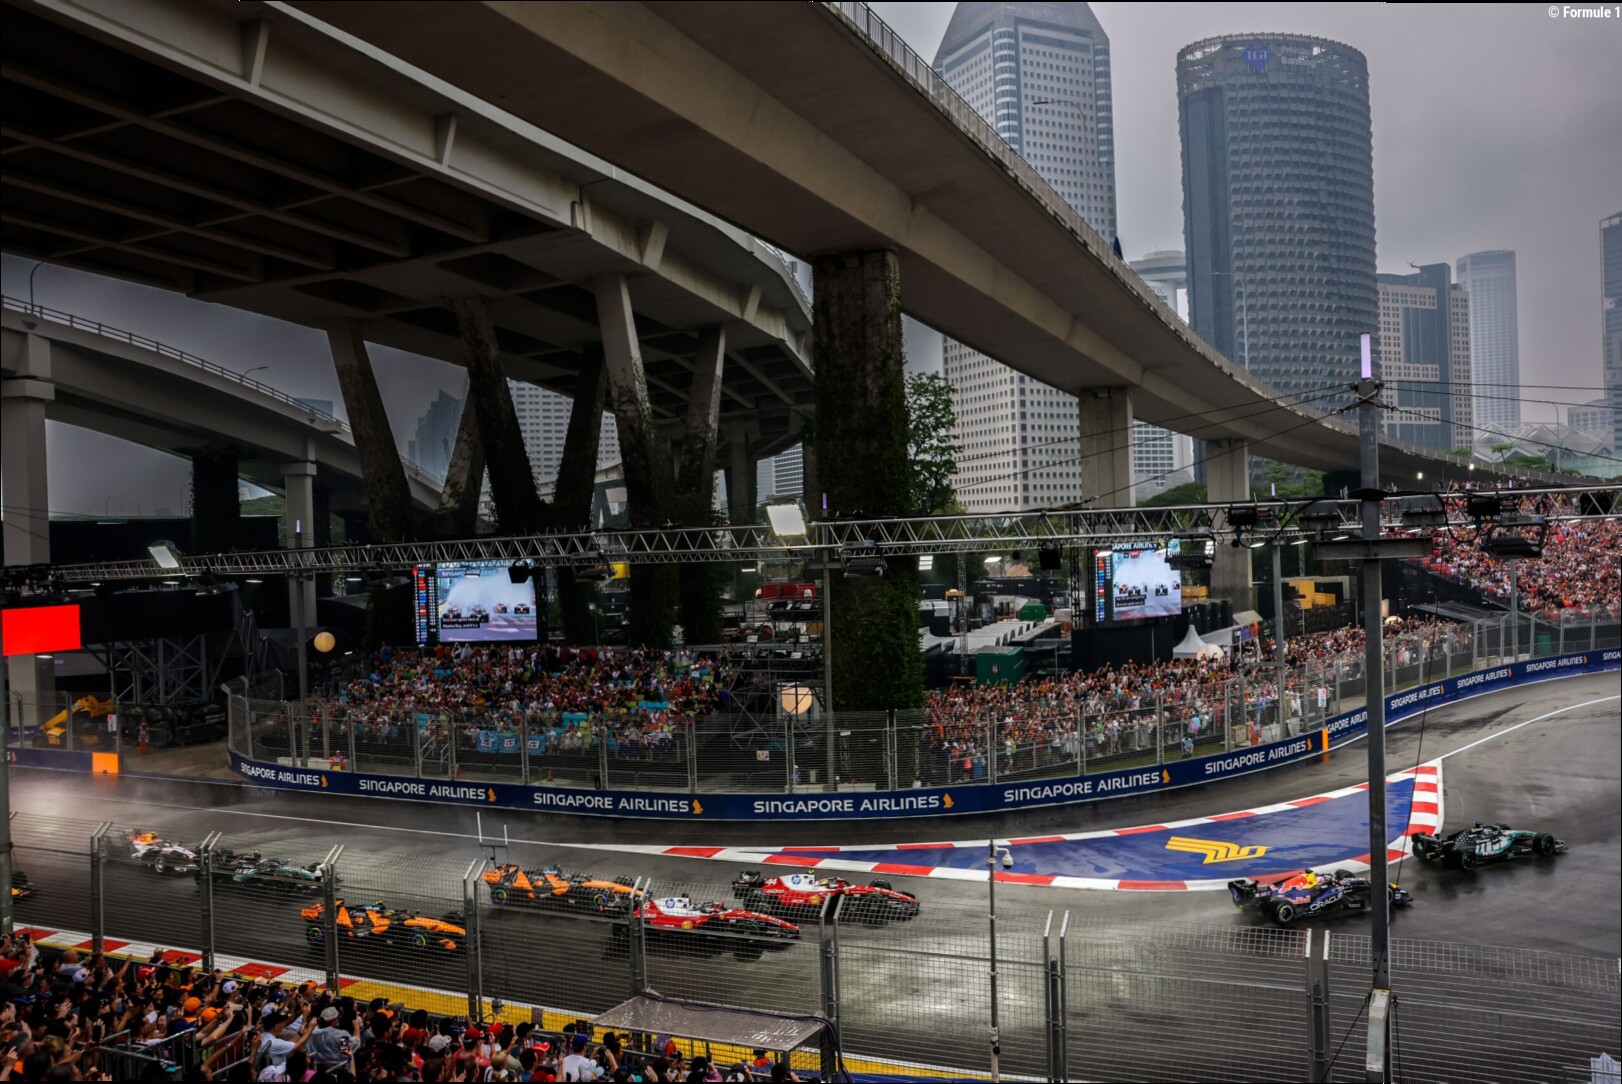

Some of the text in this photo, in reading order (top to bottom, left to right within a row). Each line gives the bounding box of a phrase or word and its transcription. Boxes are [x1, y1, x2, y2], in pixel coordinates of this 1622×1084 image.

[1526, 655, 1583, 673] SINGAPORE AIRLINES
[1603, 650, 1621, 660] SINGA
[1457, 668, 1508, 689] SINGAPORE AIRLINES
[1390, 694, 1418, 710] SINGAPORE
[1327, 711, 1368, 734] GAPORE AIRLIN
[1205, 740, 1307, 775] SINGAPORE AIRLINES
[240, 762, 320, 786] SINGAPORE AIRLINES
[359, 779, 486, 800] SINGAPORE AIRLINES
[1004, 771, 1160, 803] SINGAPORE AIRLINES
[533, 792, 689, 813] SINGAPORE AIRLINES
[753, 795, 940, 813] SINGAPORE AIRLINES
[1310, 892, 1343, 911] ORACLE
